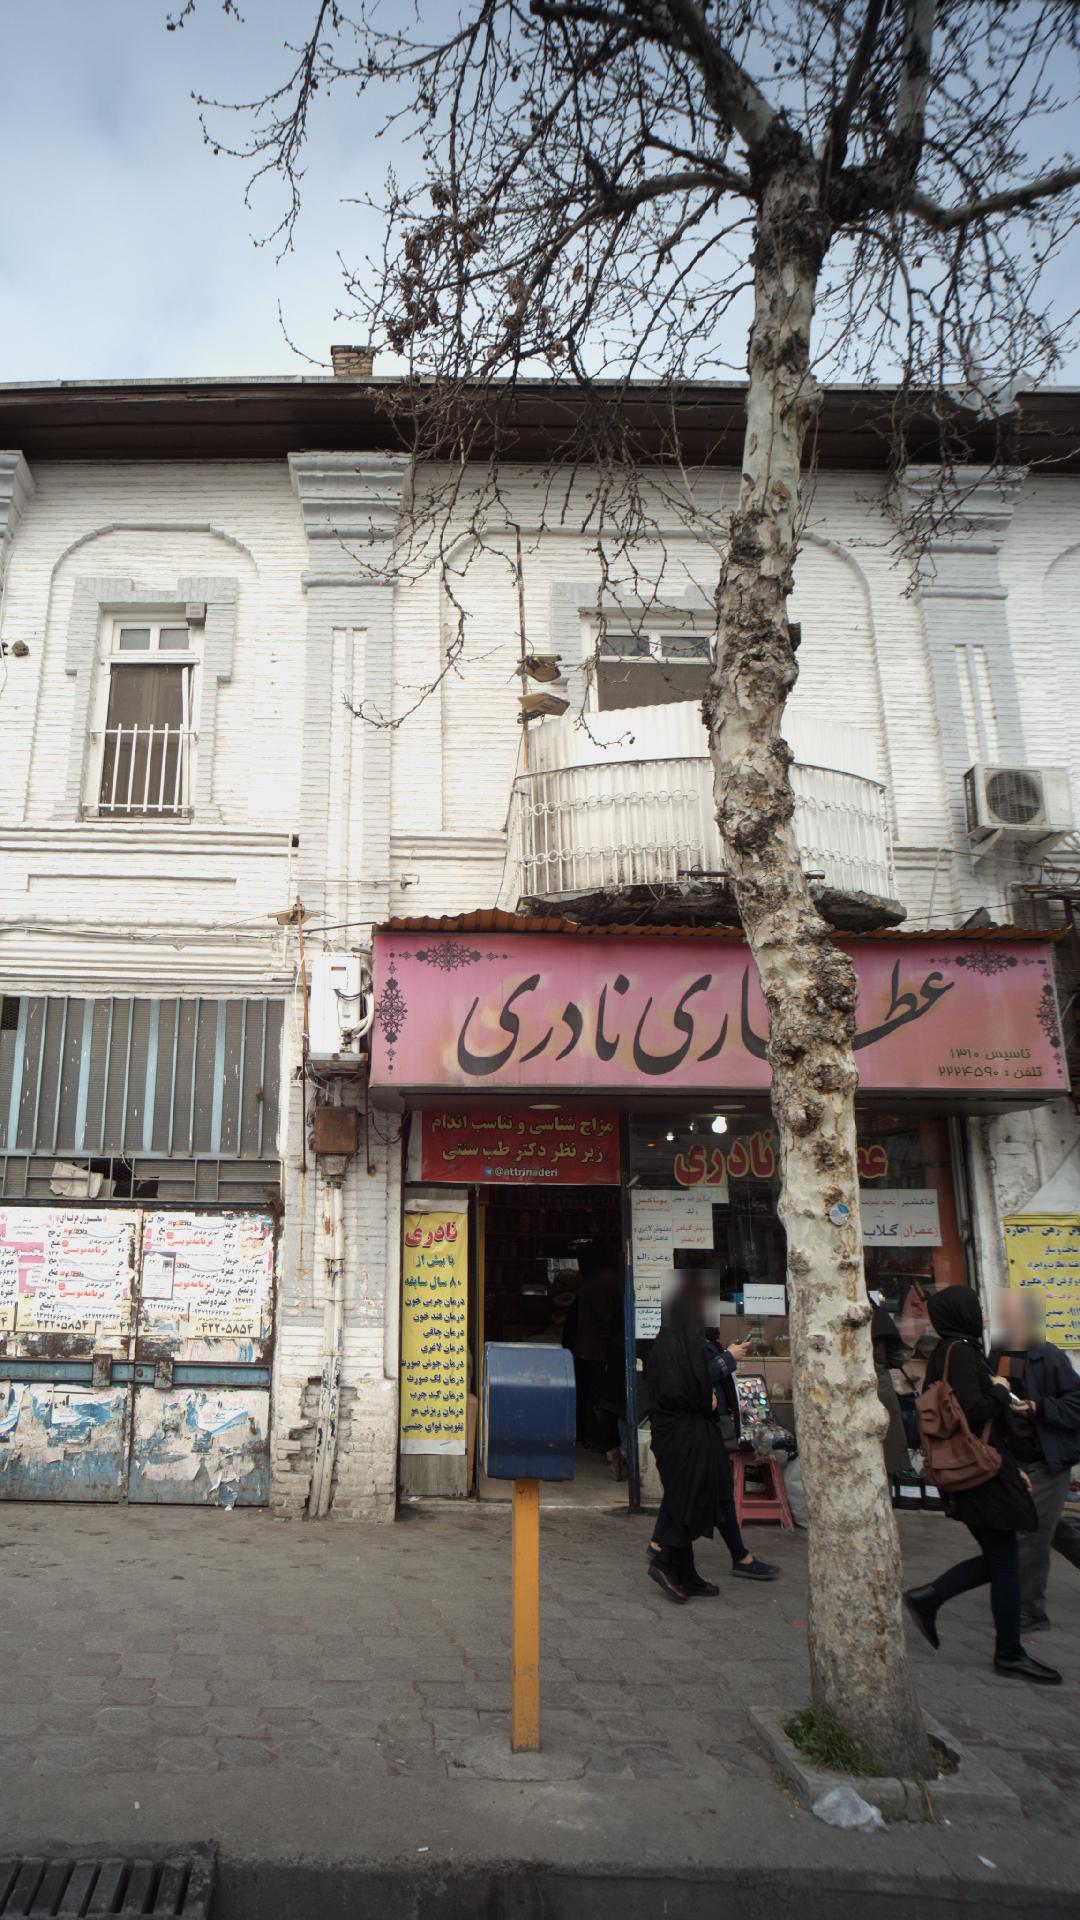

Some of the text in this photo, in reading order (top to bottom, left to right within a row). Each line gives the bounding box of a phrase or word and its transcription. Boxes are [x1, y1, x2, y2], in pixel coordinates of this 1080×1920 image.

[457, 972, 631, 1076] نادری
[949, 1048, 1032, 1062] تاسیس ۱۳۱۰
[938, 1065, 999, 1078] ۲۲۲۴۵۹۰
[1013, 1065, 1042, 1079] تلفن
[431, 1114, 614, 1137] مزاج شناسی و تناسب اندام
[442, 1140, 603, 1162] زیر نظر دکتر طب سنتی
[674, 1130, 776, 1187] نادری
[405, 1221, 459, 1249] نادری
[863, 1223, 899, 1240] گلاب
[427, 1257, 446, 1269] بیش
[447, 1254, 456, 1269] با
[404, 1276, 462, 1291] ۸۰ سال سابقه
[404, 1297, 421, 1308] خون
[443, 1298, 465, 1309] درمان
[412, 1312, 465, 1323] درمان قند خون
[422, 1327, 465, 1340] درمان چاقی
[420, 1342, 465, 1355] درمان لاغری
[422, 1359, 442, 1370] جوش
[442, 1359, 465, 1371] درمان
[406, 1374, 429, 1386] صورت
[442, 1374, 465, 1387] درمان
[409, 1390, 427, 1402] چرب
[442, 1390, 465, 1403] درمان
[410, 1407, 420, 1417] مو
[442, 1406, 465, 1419] درمان
[401, 1421, 423, 1434] جنسی
